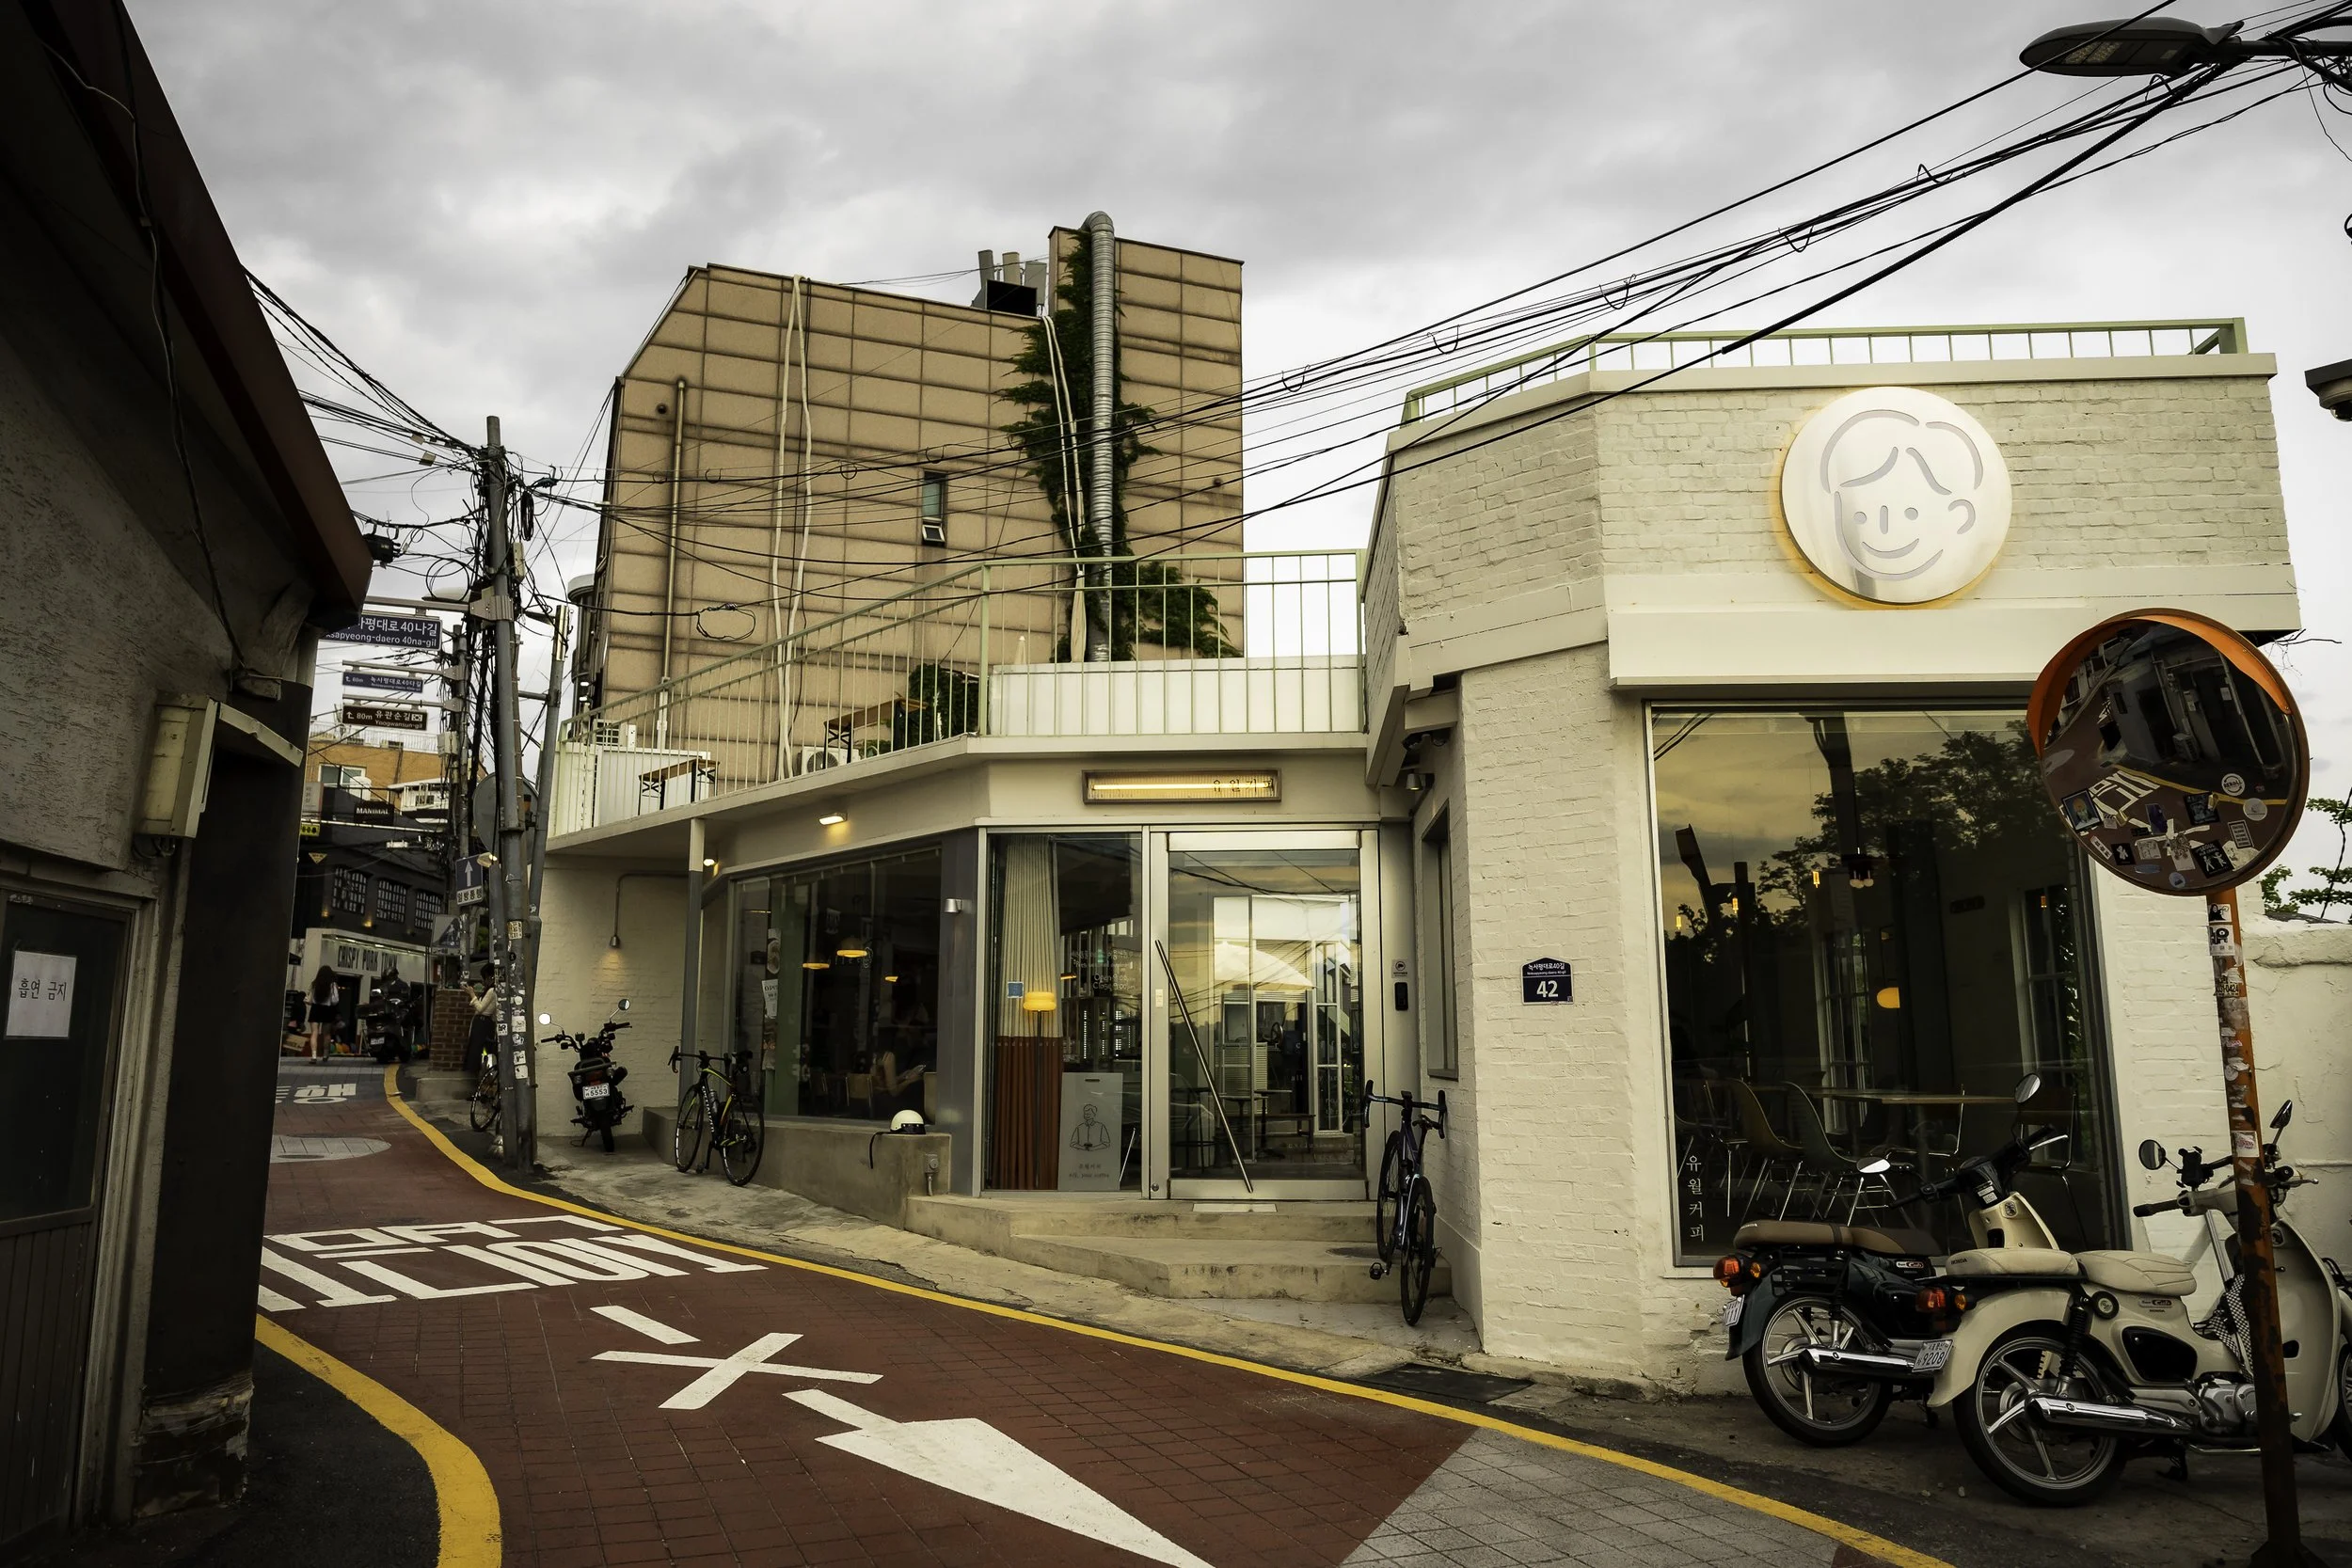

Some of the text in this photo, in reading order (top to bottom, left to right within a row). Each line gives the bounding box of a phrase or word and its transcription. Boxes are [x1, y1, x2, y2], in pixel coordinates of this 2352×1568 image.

[402, 636, 437, 647] 40na-gil
[357, 709, 410, 721] 80m 유관순길
[374, 719, 422, 729] Yoogwansun-gil
[338, 945, 360, 970] CRISPY
[362, 948, 379, 972] PORK
[19, 977, 67, 1002] 흡연 금지
[1536, 979, 1559, 998] 42
[1686, 1154, 1705, 1243] 유월커피
[1922, 1351, 1947, 1366] 9208
